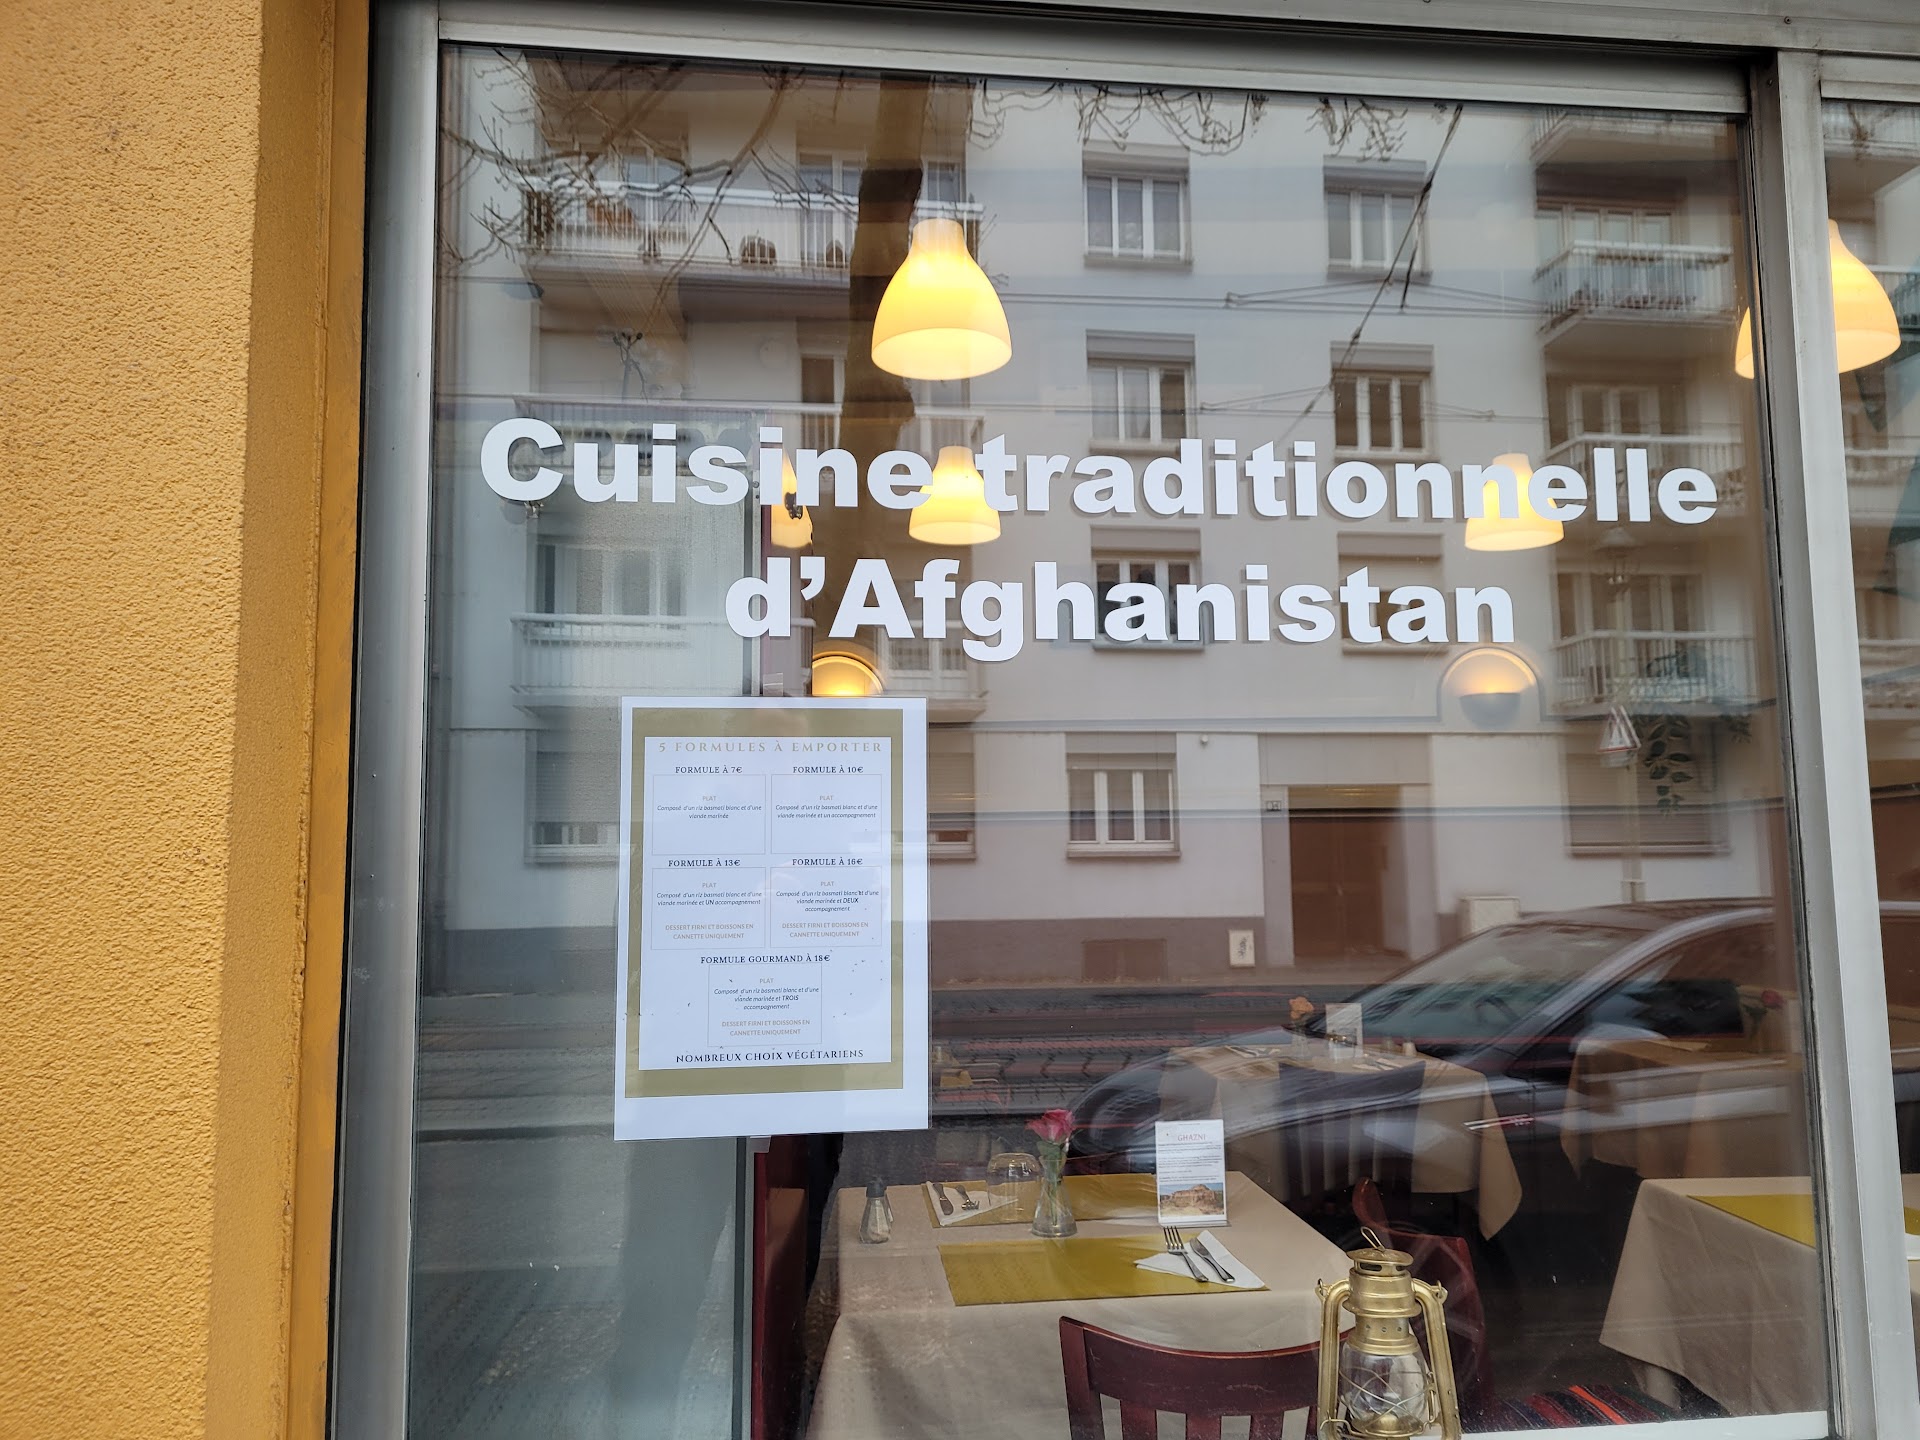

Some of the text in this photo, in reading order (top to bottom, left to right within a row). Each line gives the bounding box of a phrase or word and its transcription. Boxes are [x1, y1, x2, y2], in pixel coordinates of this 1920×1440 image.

[480, 418, 1718, 525] Cuisine traditionnelle
[659, 740, 881, 752] 5 FORMULES À EMPORTER
[723, 765, 728, 773] À
[839, 765, 844, 773] À
[716, 858, 722, 866] À
[839, 857, 844, 865] À
[749, 955, 803, 963] GOURMAND
[806, 953, 812, 961] À
[676, 1049, 864, 1063] NOMBREUX CHOIX VÉGÉTARIENS
